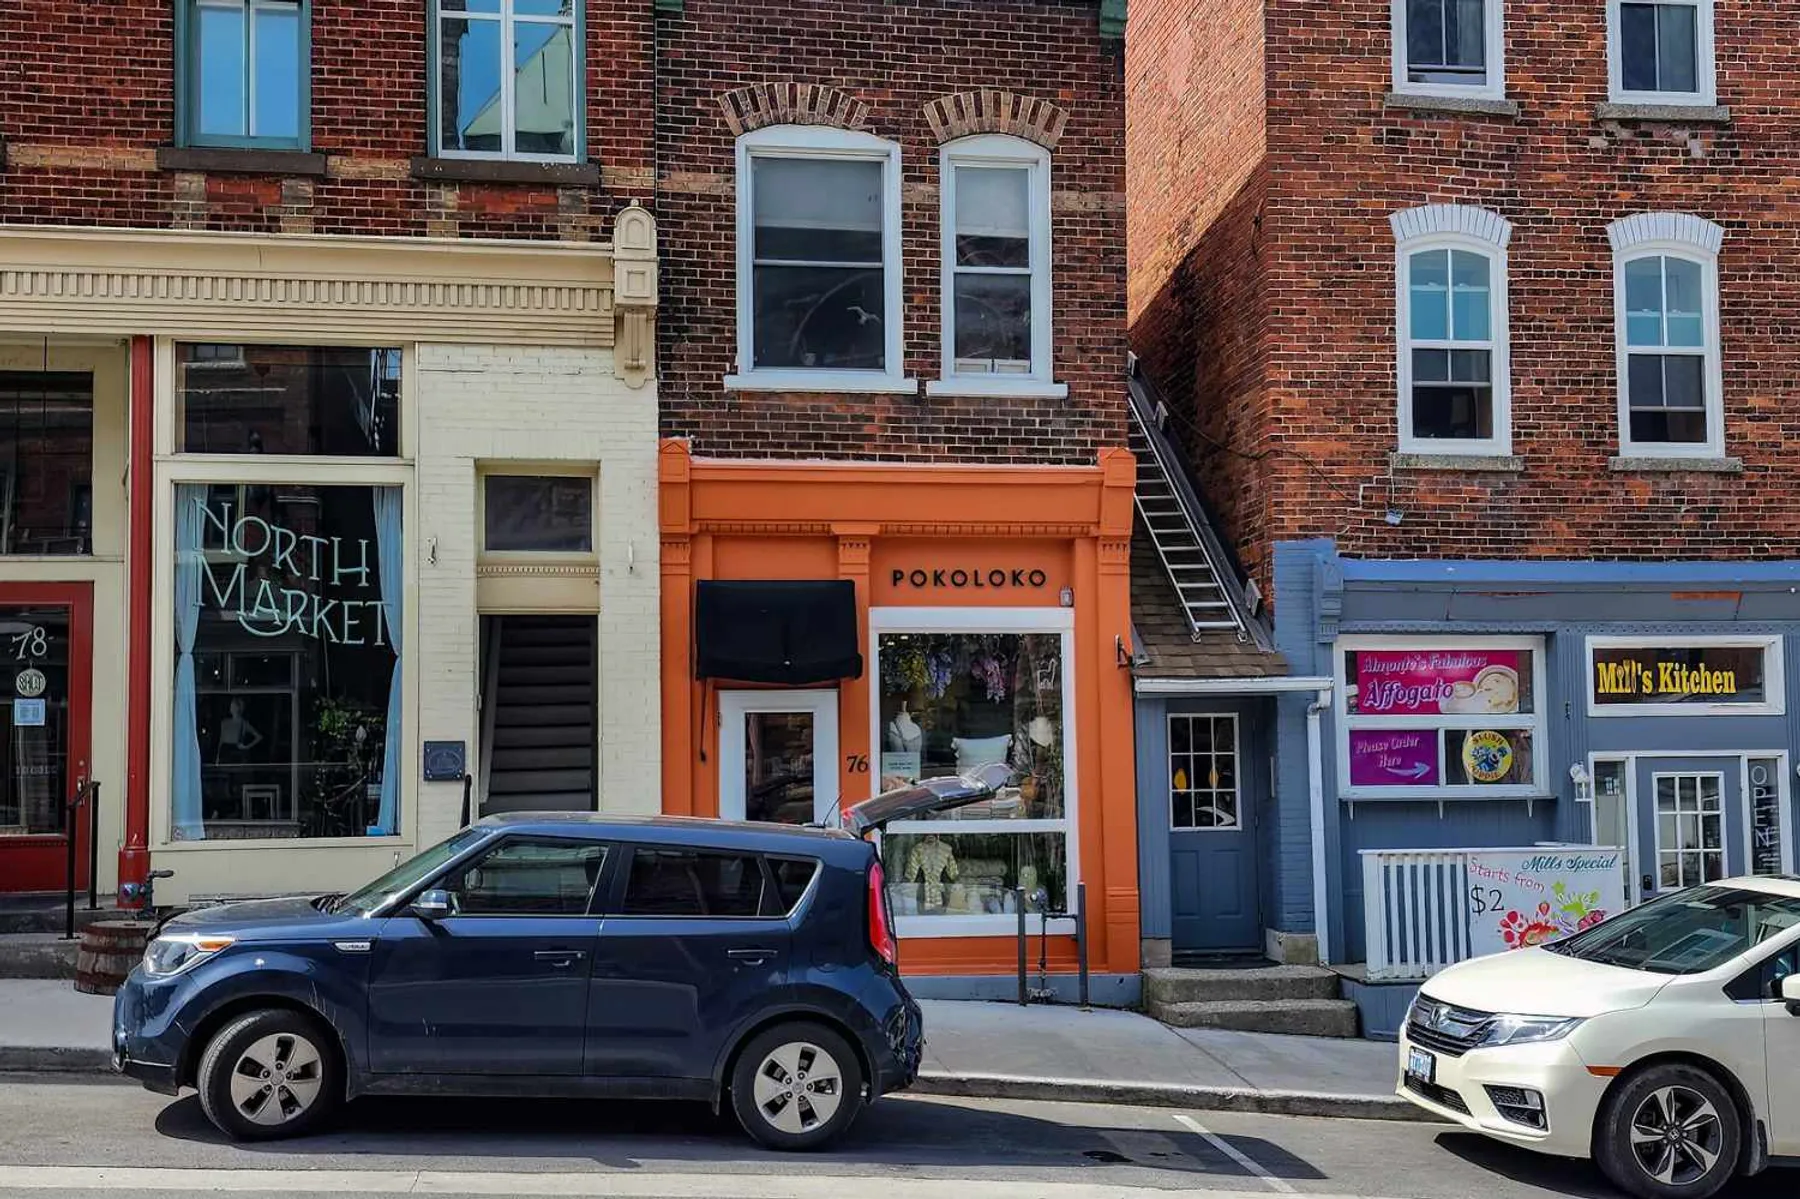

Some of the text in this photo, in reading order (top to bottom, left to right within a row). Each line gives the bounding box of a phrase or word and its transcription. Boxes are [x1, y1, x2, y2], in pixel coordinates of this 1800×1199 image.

[194, 497, 370, 587] NORTH
[892, 569, 1046, 588] POKOLOKO
[194, 549, 393, 646] MARKET
[11, 627, 47, 660] 78
[1363, 677, 1453, 710] Affogato
[1657, 662, 1737, 694] Kitchen
[847, 754, 868, 773] 76
[1751, 765, 1770, 848] OPEN
[1469, 857, 1546, 894] Starts from
[1522, 853, 1619, 873] Mills Special
[1470, 884, 1505, 917] $2
